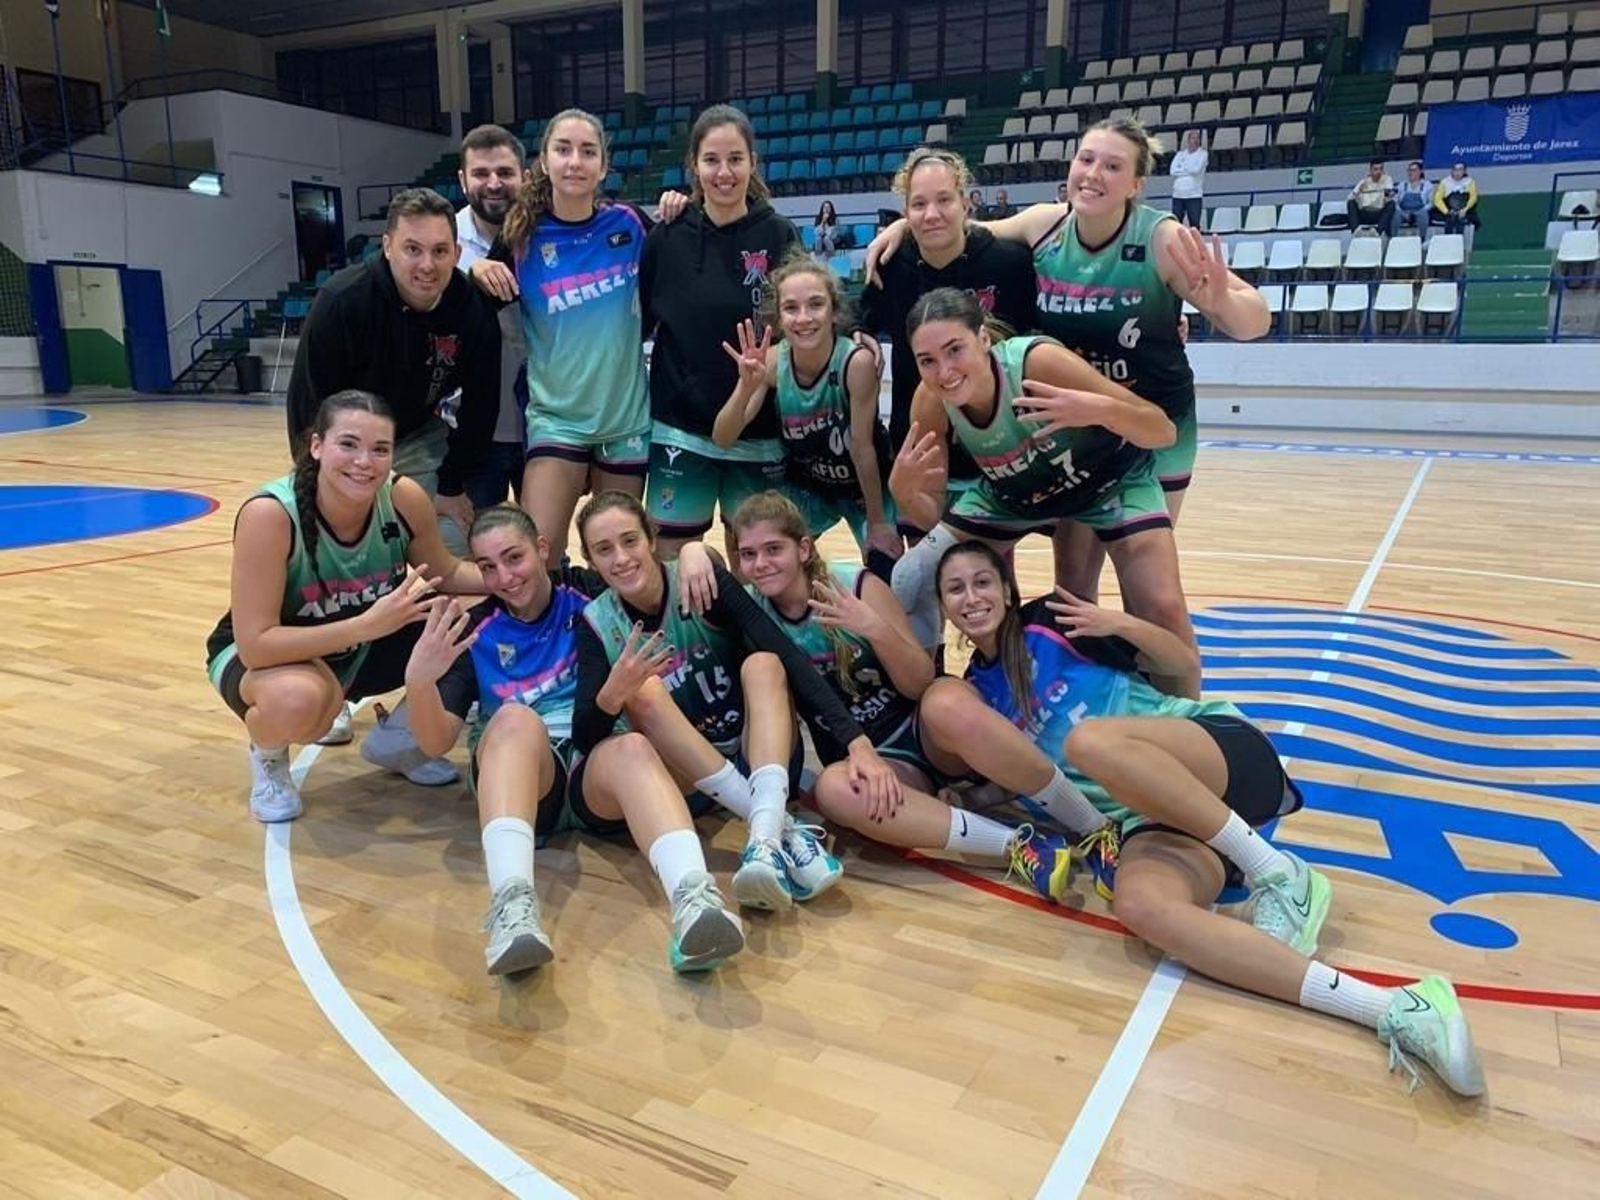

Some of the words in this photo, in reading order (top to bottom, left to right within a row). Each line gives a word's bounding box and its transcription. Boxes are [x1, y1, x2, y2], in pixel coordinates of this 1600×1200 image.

[1451, 141, 1530, 156] Ayuntamiento
[1533, 139, 1547, 151] de
[1117, 316, 1142, 349] 6
[695, 665, 732, 704] 15
